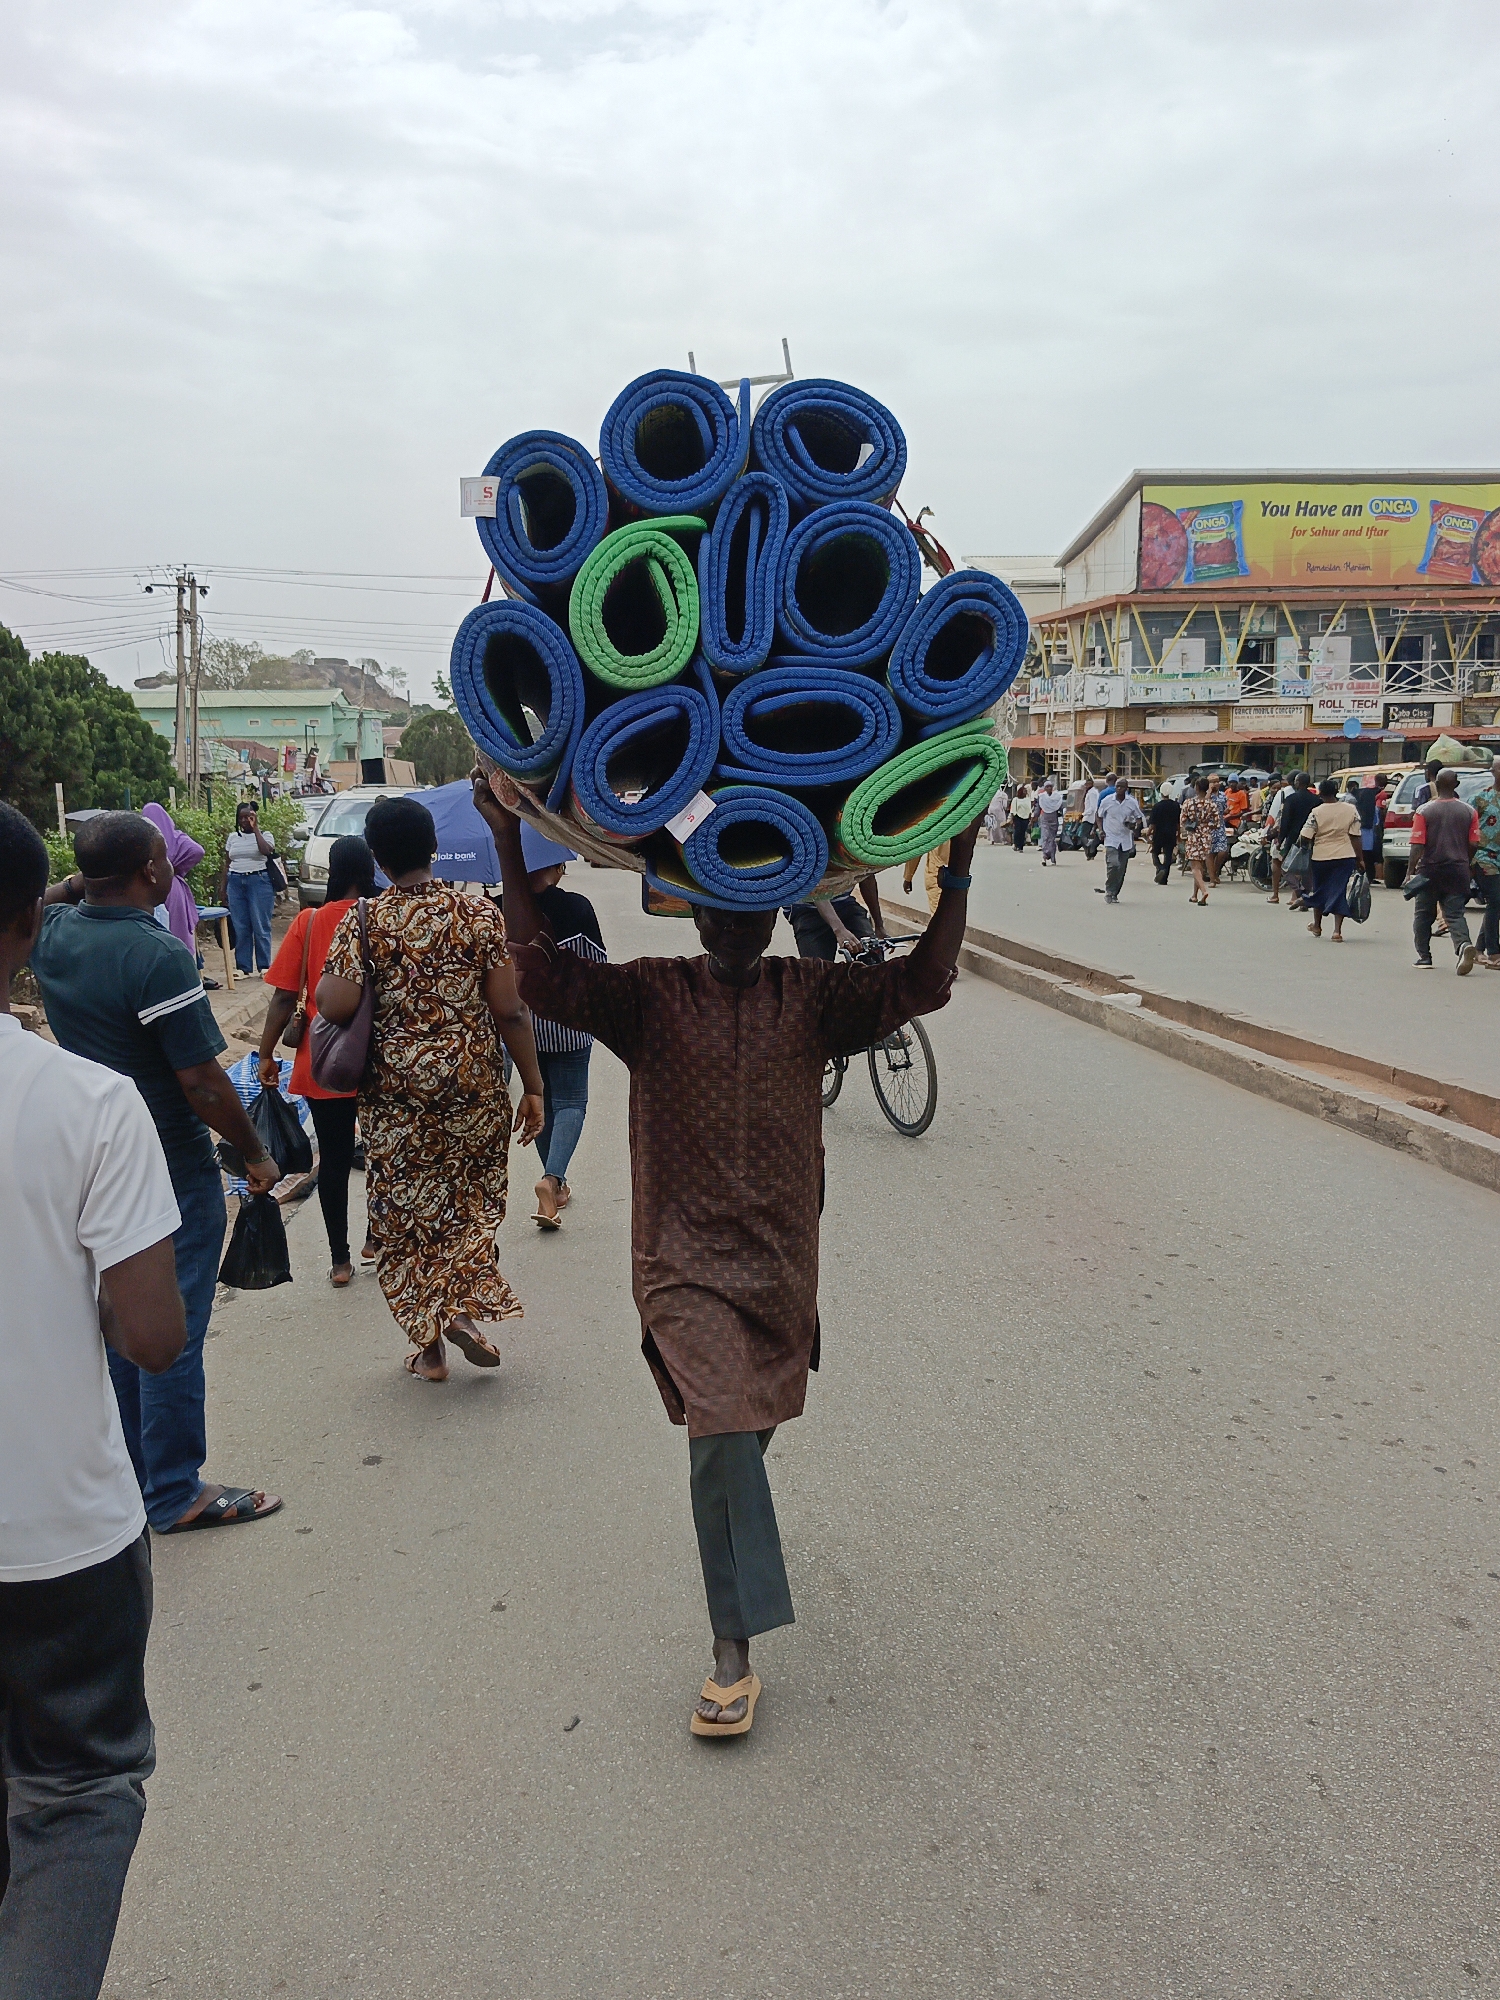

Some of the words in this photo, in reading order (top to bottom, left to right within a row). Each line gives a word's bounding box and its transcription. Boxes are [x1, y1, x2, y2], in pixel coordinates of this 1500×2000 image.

[1260, 500, 1290, 517] You
[1295, 500, 1338, 517] Have
[1341, 504, 1363, 517] an
[1371, 499, 1414, 514] ONGA
[1195, 516, 1226, 530] ONGA
[1444, 516, 1473, 530] ONGA
[1289, 526, 1307, 540] for
[1310, 526, 1340, 538] Sahur
[1342, 526, 1363, 537] and
[1365, 526, 1389, 540] Iftar
[1234, 707, 1252, 715] GRACE
[1253, 707, 1274, 715] MOBILE
[1318, 699, 1345, 709] ROLL
[1350, 699, 1378, 709] TECH
[455, 852, 477, 860] bank
